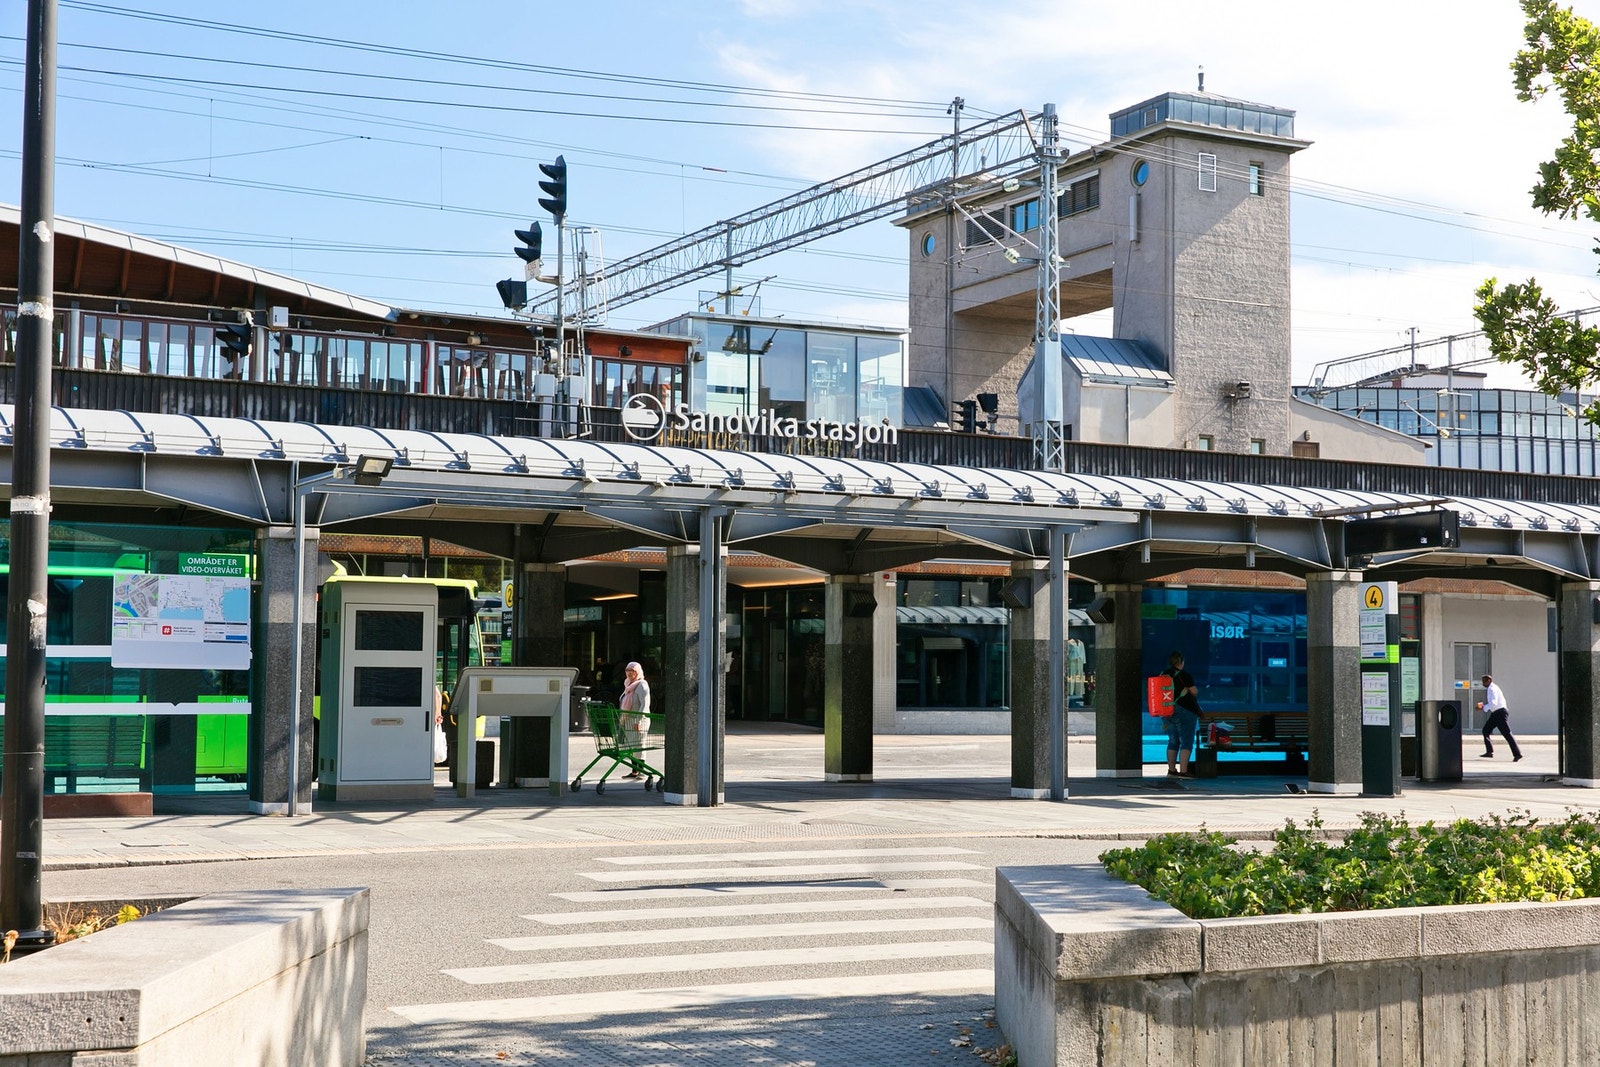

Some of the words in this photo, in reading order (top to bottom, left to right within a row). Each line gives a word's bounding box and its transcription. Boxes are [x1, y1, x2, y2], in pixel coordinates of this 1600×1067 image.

[674, 403, 798, 437] Sandvika
[806, 416, 897, 449] stasjon
[187, 557, 226, 565] OMRÅDET
[181, 565, 243, 575] VIDEO-OVERVÅKET
[508, 588, 512, 603] 2
[1369, 590, 1378, 606] 4
[1210, 625, 1245, 639] ISØR
